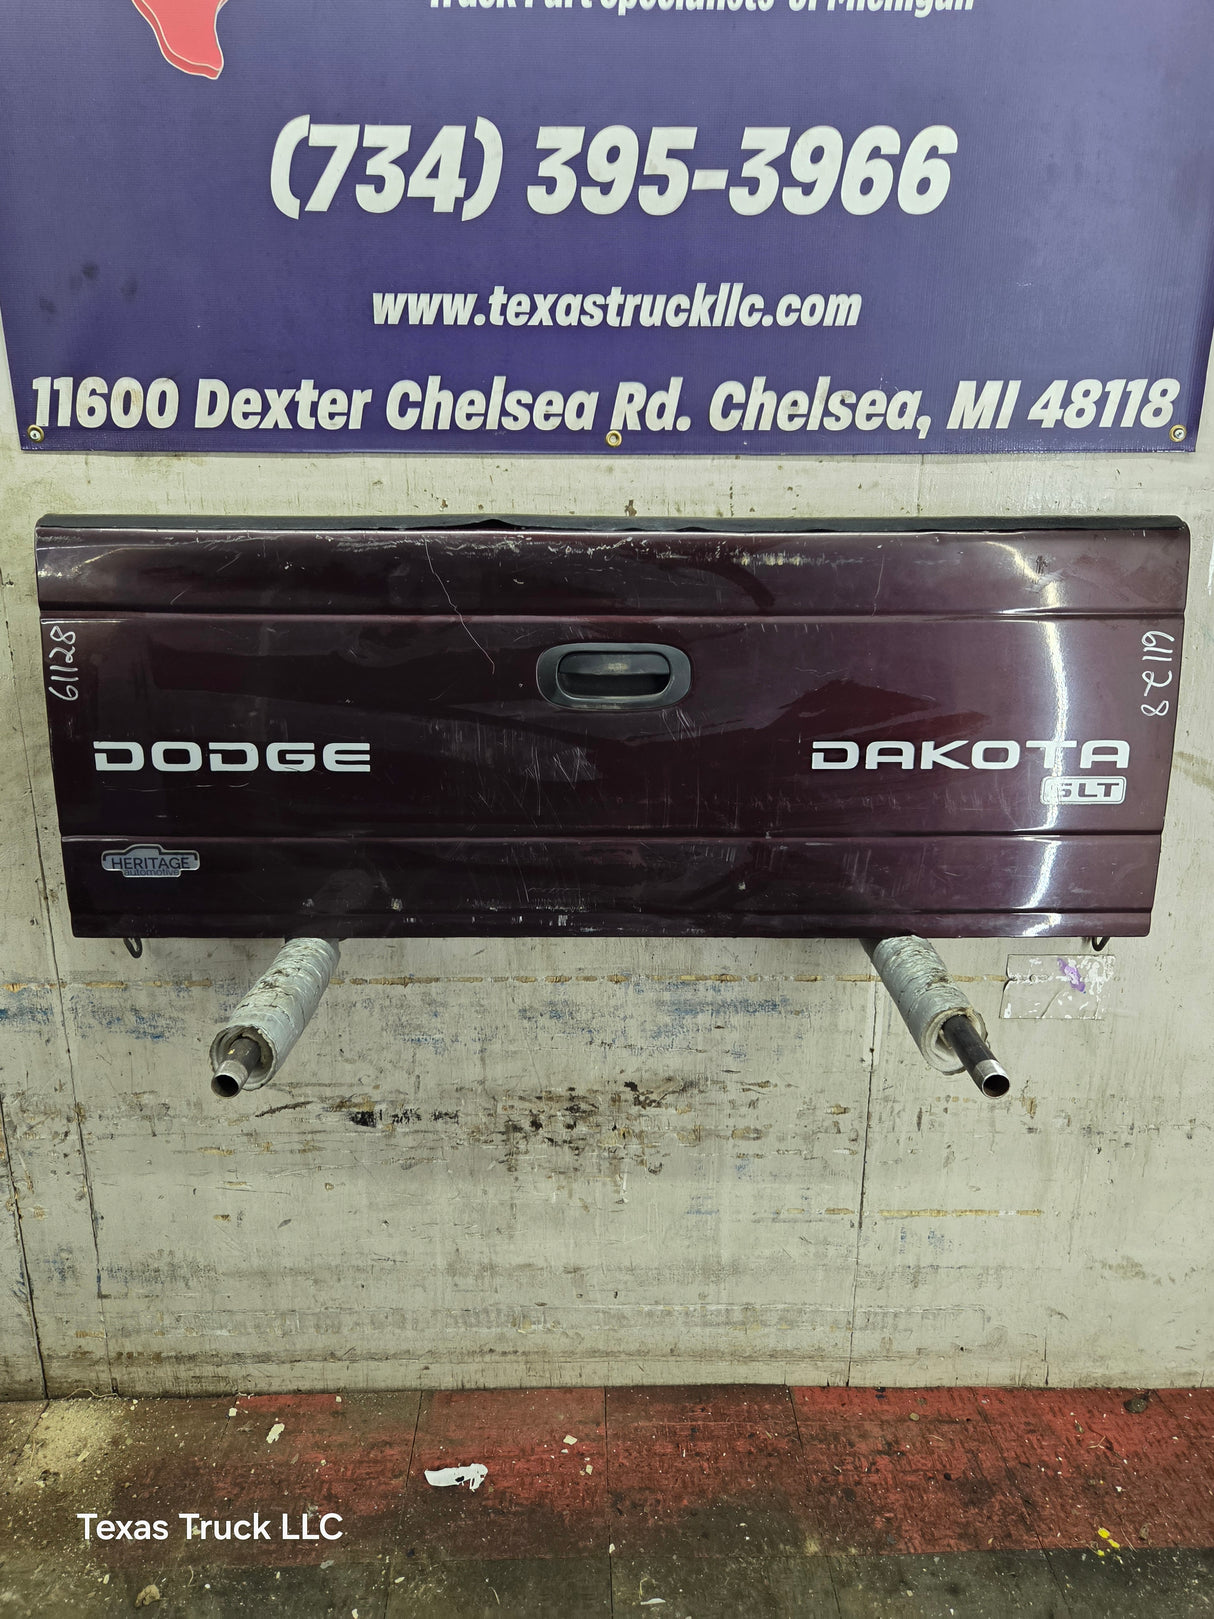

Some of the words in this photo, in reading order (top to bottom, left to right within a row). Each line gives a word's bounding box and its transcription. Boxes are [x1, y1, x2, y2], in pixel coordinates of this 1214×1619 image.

[270, 114, 504, 222] (734)
[526, 124, 960, 216] 395-3966
[371, 282, 862, 328] www.texastruckllc.com
[30, 376, 179, 430] 11600
[194, 378, 373, 431] Dexter
[386, 375, 599, 431] Chelsea
[609, 376, 692, 431] Rd.
[709, 375, 932, 440] Chelsea,
[946, 379, 1022, 430] MI
[1027, 378, 1182, 430] 48118
[48, 624, 80, 702] 61128
[93, 740, 371, 772] DODGE
[811, 739, 1130, 770] DAKOTA
[111, 857, 191, 870] HERITAGE
[124, 867, 180, 877] automotive
